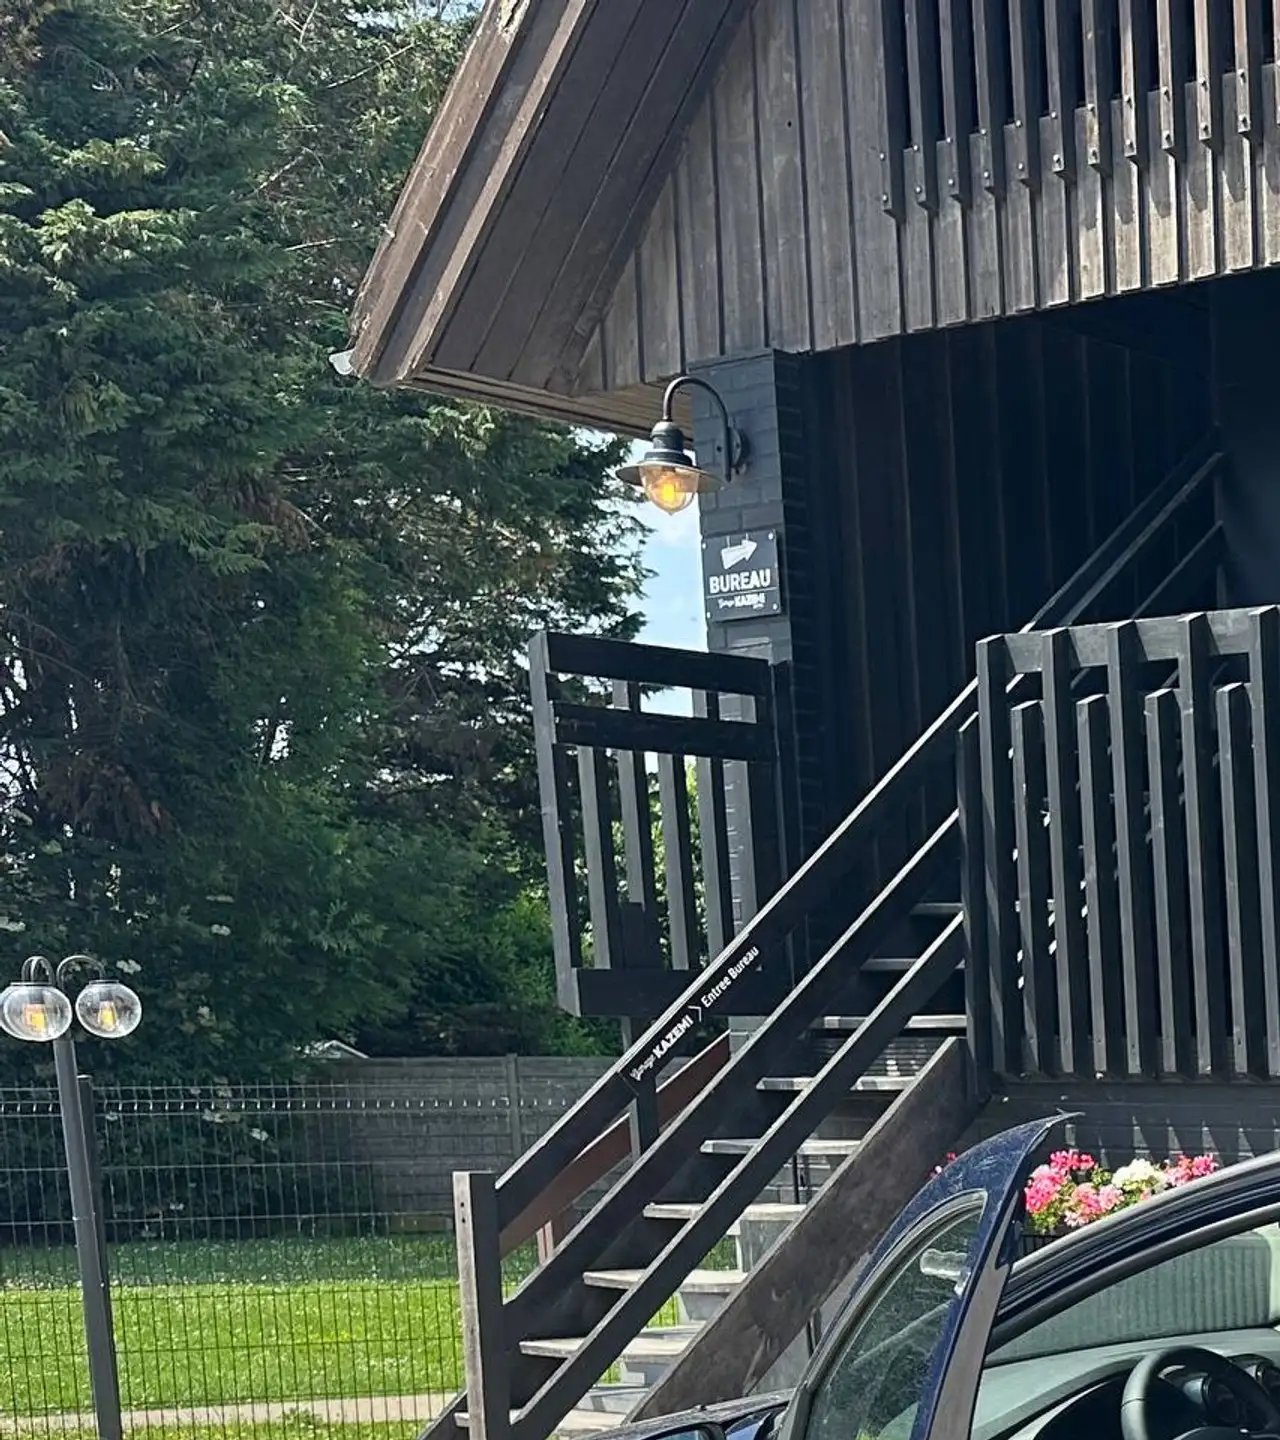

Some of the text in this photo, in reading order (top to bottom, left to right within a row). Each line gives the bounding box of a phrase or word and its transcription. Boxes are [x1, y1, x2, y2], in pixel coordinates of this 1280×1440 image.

[709, 569, 771, 594] BUREAU
[653, 1015, 694, 1059] KAZEMI
[728, 946, 760, 979] Bureau
